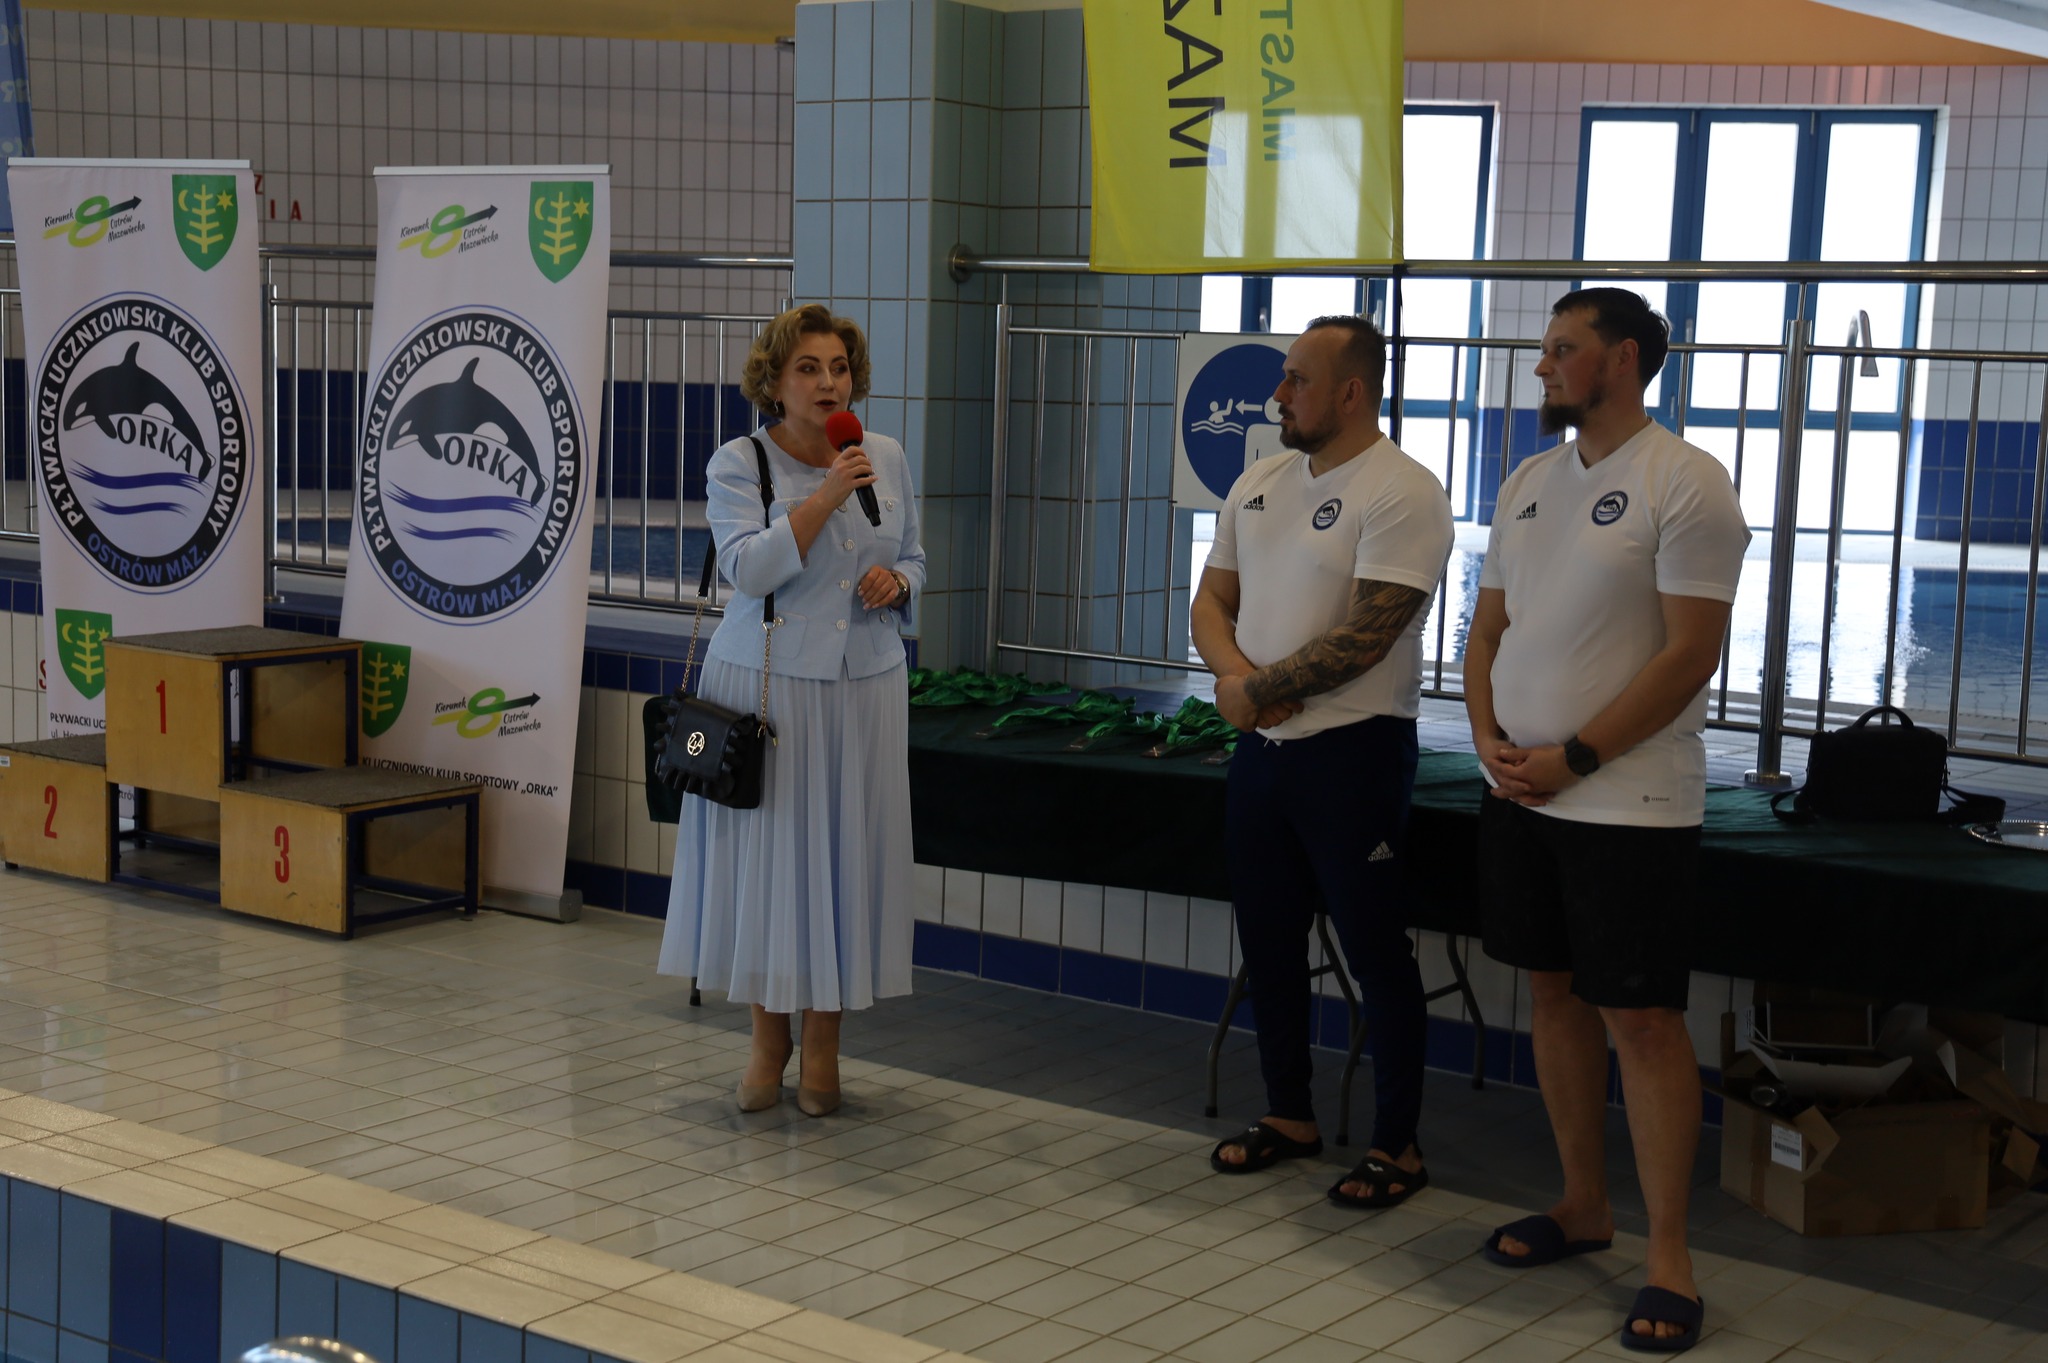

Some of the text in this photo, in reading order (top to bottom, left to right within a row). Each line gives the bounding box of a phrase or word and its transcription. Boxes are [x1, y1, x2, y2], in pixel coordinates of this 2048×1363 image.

[44, 208, 74, 228] Kierunek
[400, 217, 430, 238] Kierunek
[463, 223, 487, 240] Ostrów
[458, 230, 498, 254] Mazowiecka
[40, 306, 240, 537] PŁYWACKI UCZNIOWSKI KLUB SPORTOWY
[363, 319, 575, 565] PŁYWACKI UCZNIOWSKI KLUB SPORTOWY
[117, 416, 193, 474] ORKA
[443, 435, 528, 498] ORKA
[88, 532, 207, 583] OSTRÓW MAZ.
[391, 559, 532, 614] OSTRÓW MAZ.
[50, 712, 91, 727] PŁYWACKI
[156, 680, 167, 734] 1
[435, 697, 466, 714] Kierunek
[503, 710, 530, 724] Ostrów
[498, 719, 541, 738] Mazowiecka
[373, 757, 434, 778] UCZNIOWSKI
[463, 772, 519, 791] SPORTOWY
[44, 785, 58, 839] 2
[274, 825, 290, 883] 3
